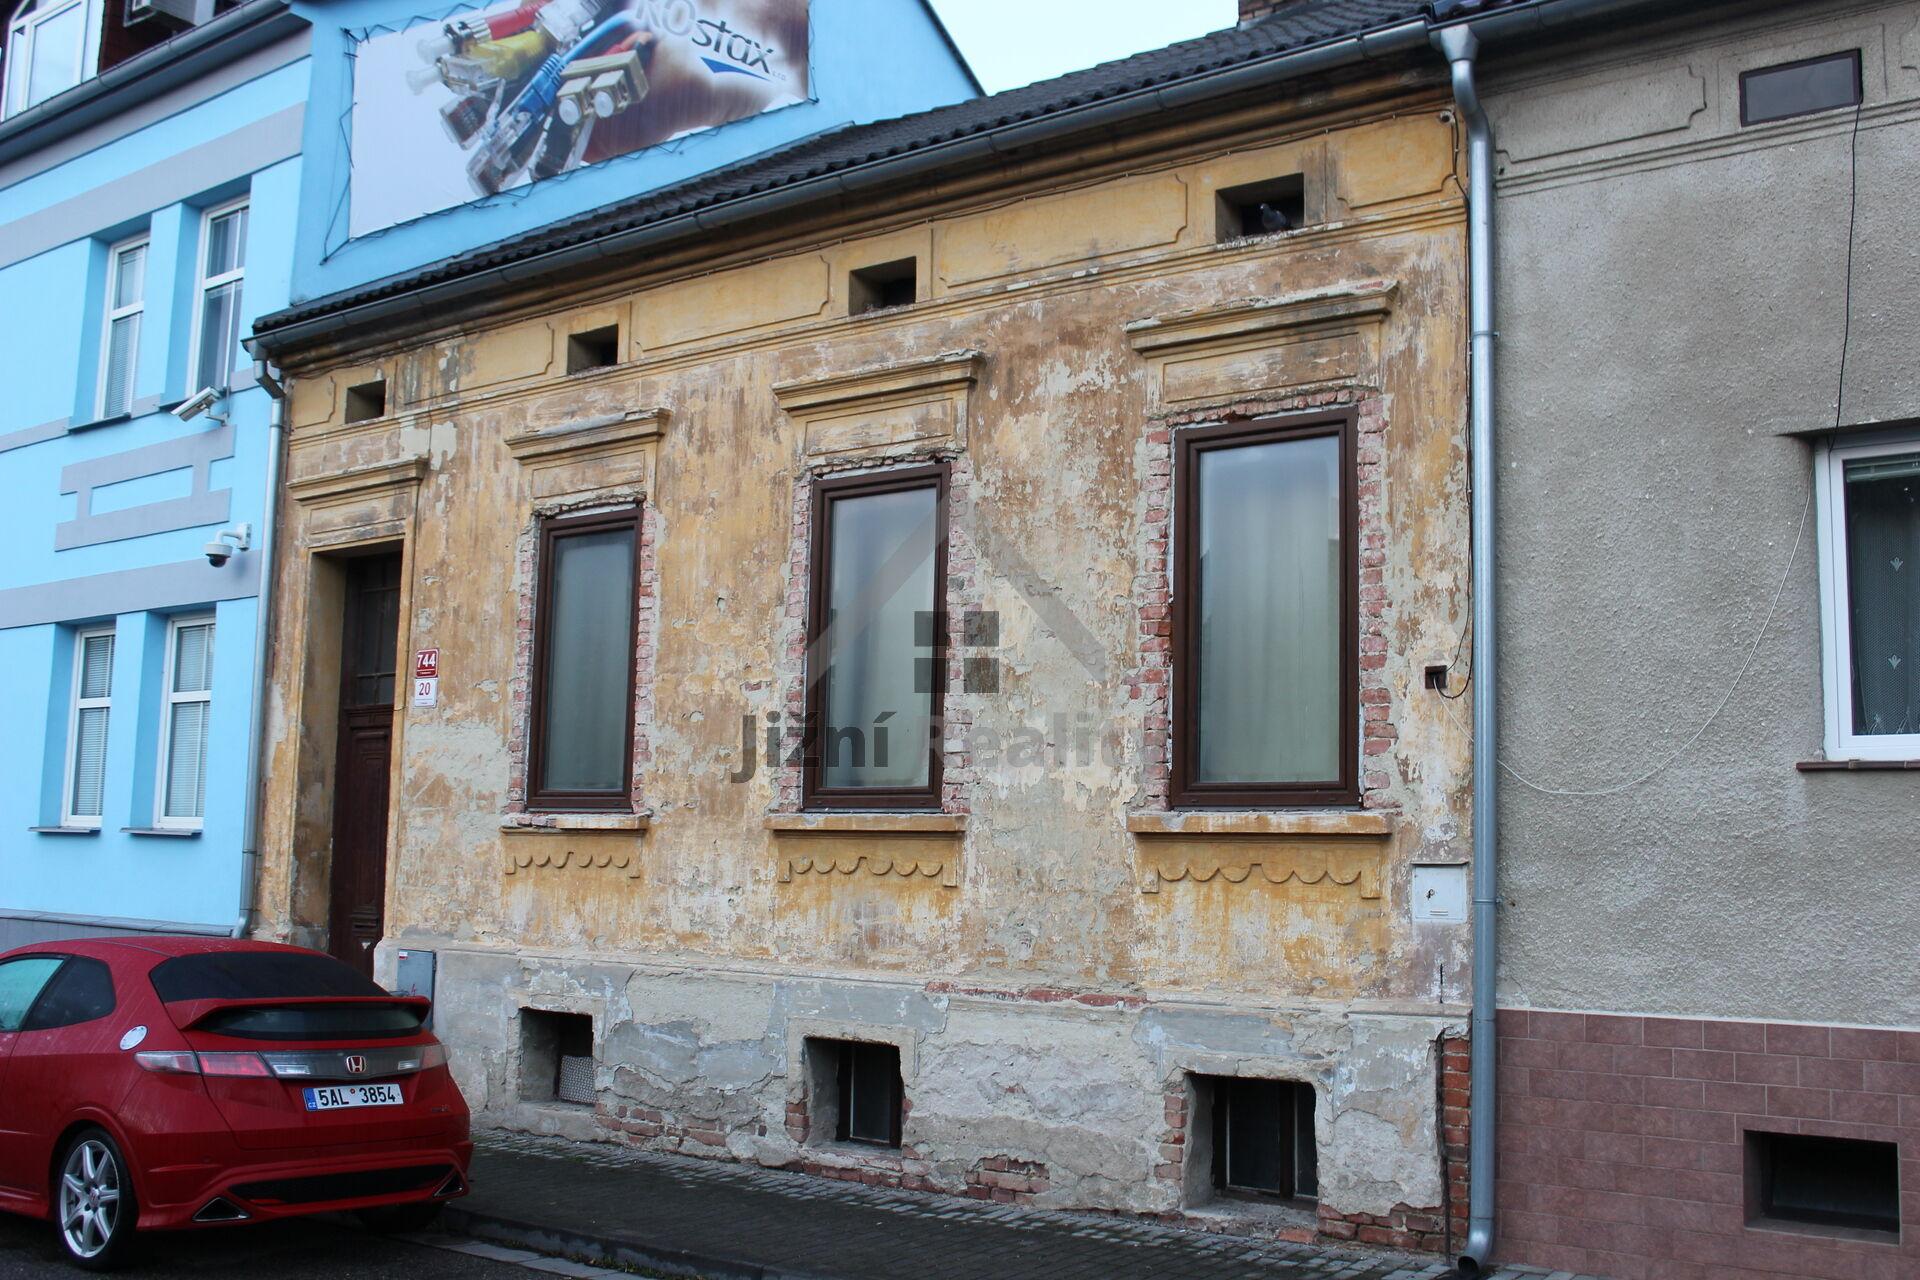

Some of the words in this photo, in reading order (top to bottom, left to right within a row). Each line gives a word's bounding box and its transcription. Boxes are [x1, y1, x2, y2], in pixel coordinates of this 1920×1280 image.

[417, 653, 436, 668] 744
[418, 682, 431, 696] 20
[317, 1089, 350, 1107] 5AL
[358, 1086, 396, 1104] 3854
